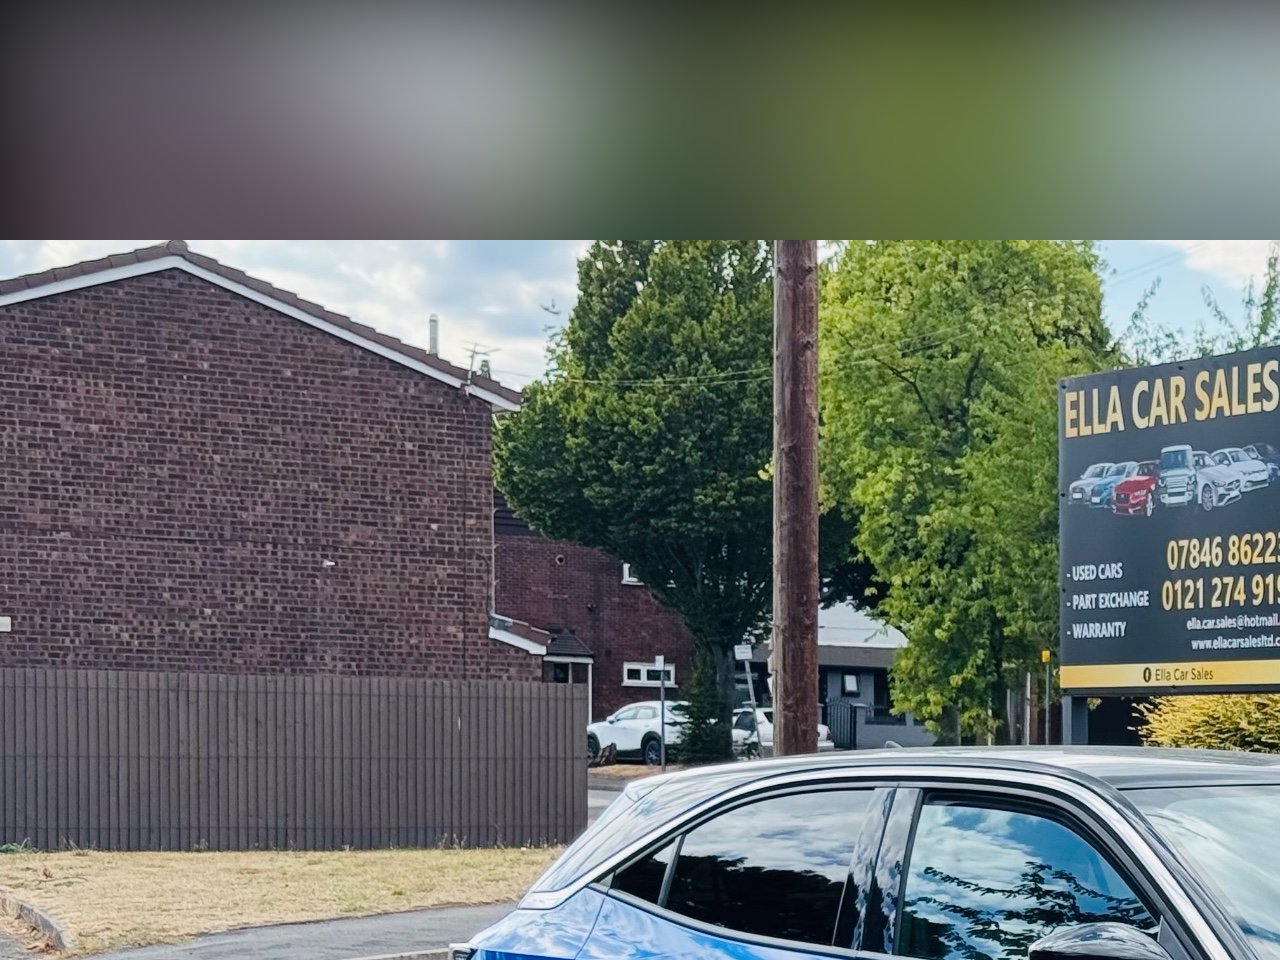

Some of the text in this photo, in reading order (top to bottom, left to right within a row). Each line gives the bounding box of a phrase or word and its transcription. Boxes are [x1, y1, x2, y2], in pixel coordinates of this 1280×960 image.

[1065, 385, 1125, 438] ELLA
[1132, 375, 1187, 429] CAR
[1194, 360, 1280, 421] SALES
[1167, 536, 1222, 571] 07846
[1072, 564, 1097, 581] USED
[1098, 562, 1123, 580] CARS
[1072, 593, 1097, 610] PART
[1099, 590, 1150, 609] EXCHANGE
[1162, 578, 1204, 611] 0121
[1211, 576, 1246, 608] 274
[1072, 621, 1127, 639] WARRANTY
[1155, 667, 1214, 681] Ella Car Sales
